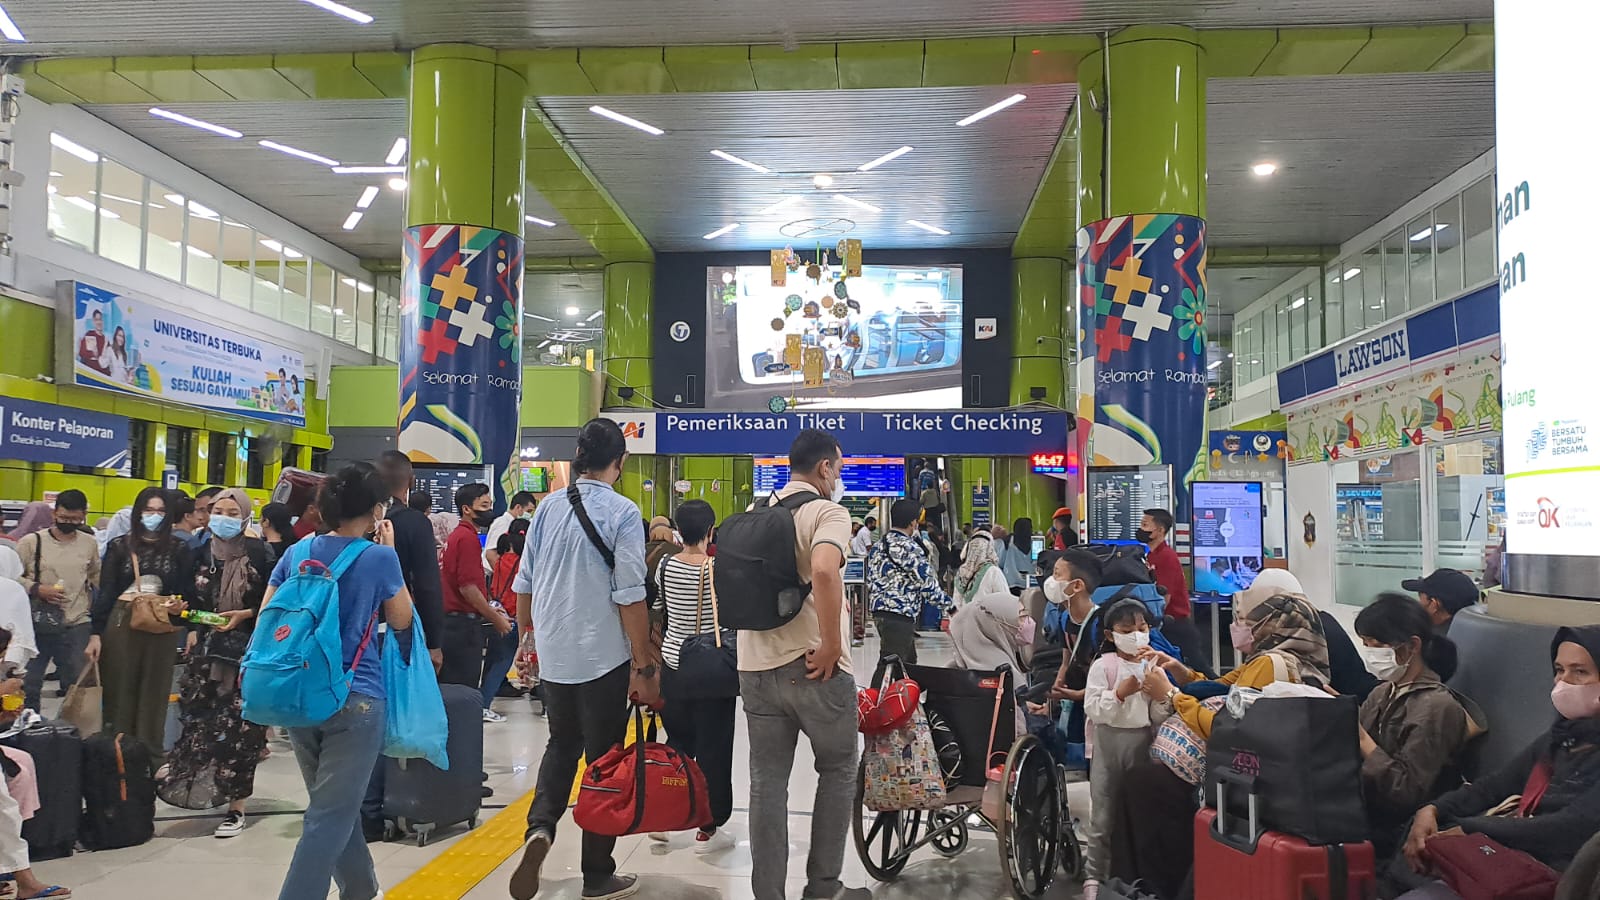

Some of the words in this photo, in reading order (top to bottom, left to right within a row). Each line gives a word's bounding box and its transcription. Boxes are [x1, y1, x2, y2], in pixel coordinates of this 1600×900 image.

[153, 319, 220, 350] UNIVERSITAS
[221, 339, 262, 362] TERBUKA
[1337, 329, 1406, 377] LAWSON
[192, 365, 232, 385] KULIAH
[422, 369, 480, 385] Selamat
[1098, 368, 1156, 384] Selamat
[171, 377, 206, 394] SESUAI
[207, 383, 250, 401] GAYAMU!
[11, 411, 56, 431] Konter
[58, 418, 114, 439] Pelaporan
[619, 421, 646, 439] AI
[666, 414, 788, 431] Pemeriksaan
[796, 413, 846, 430] Tiket
[882, 413, 943, 431] Ticket
[951, 413, 1043, 434] Checking
[1551, 425, 1587, 438] BERSATU
[10, 433, 42, 445] Check-in
[44, 438, 71, 449] Counter
[1552, 436, 1583, 447] TUMBUH
[1552, 444, 1589, 456] BERSAMA
[1032, 454, 1064, 466] 14:47
